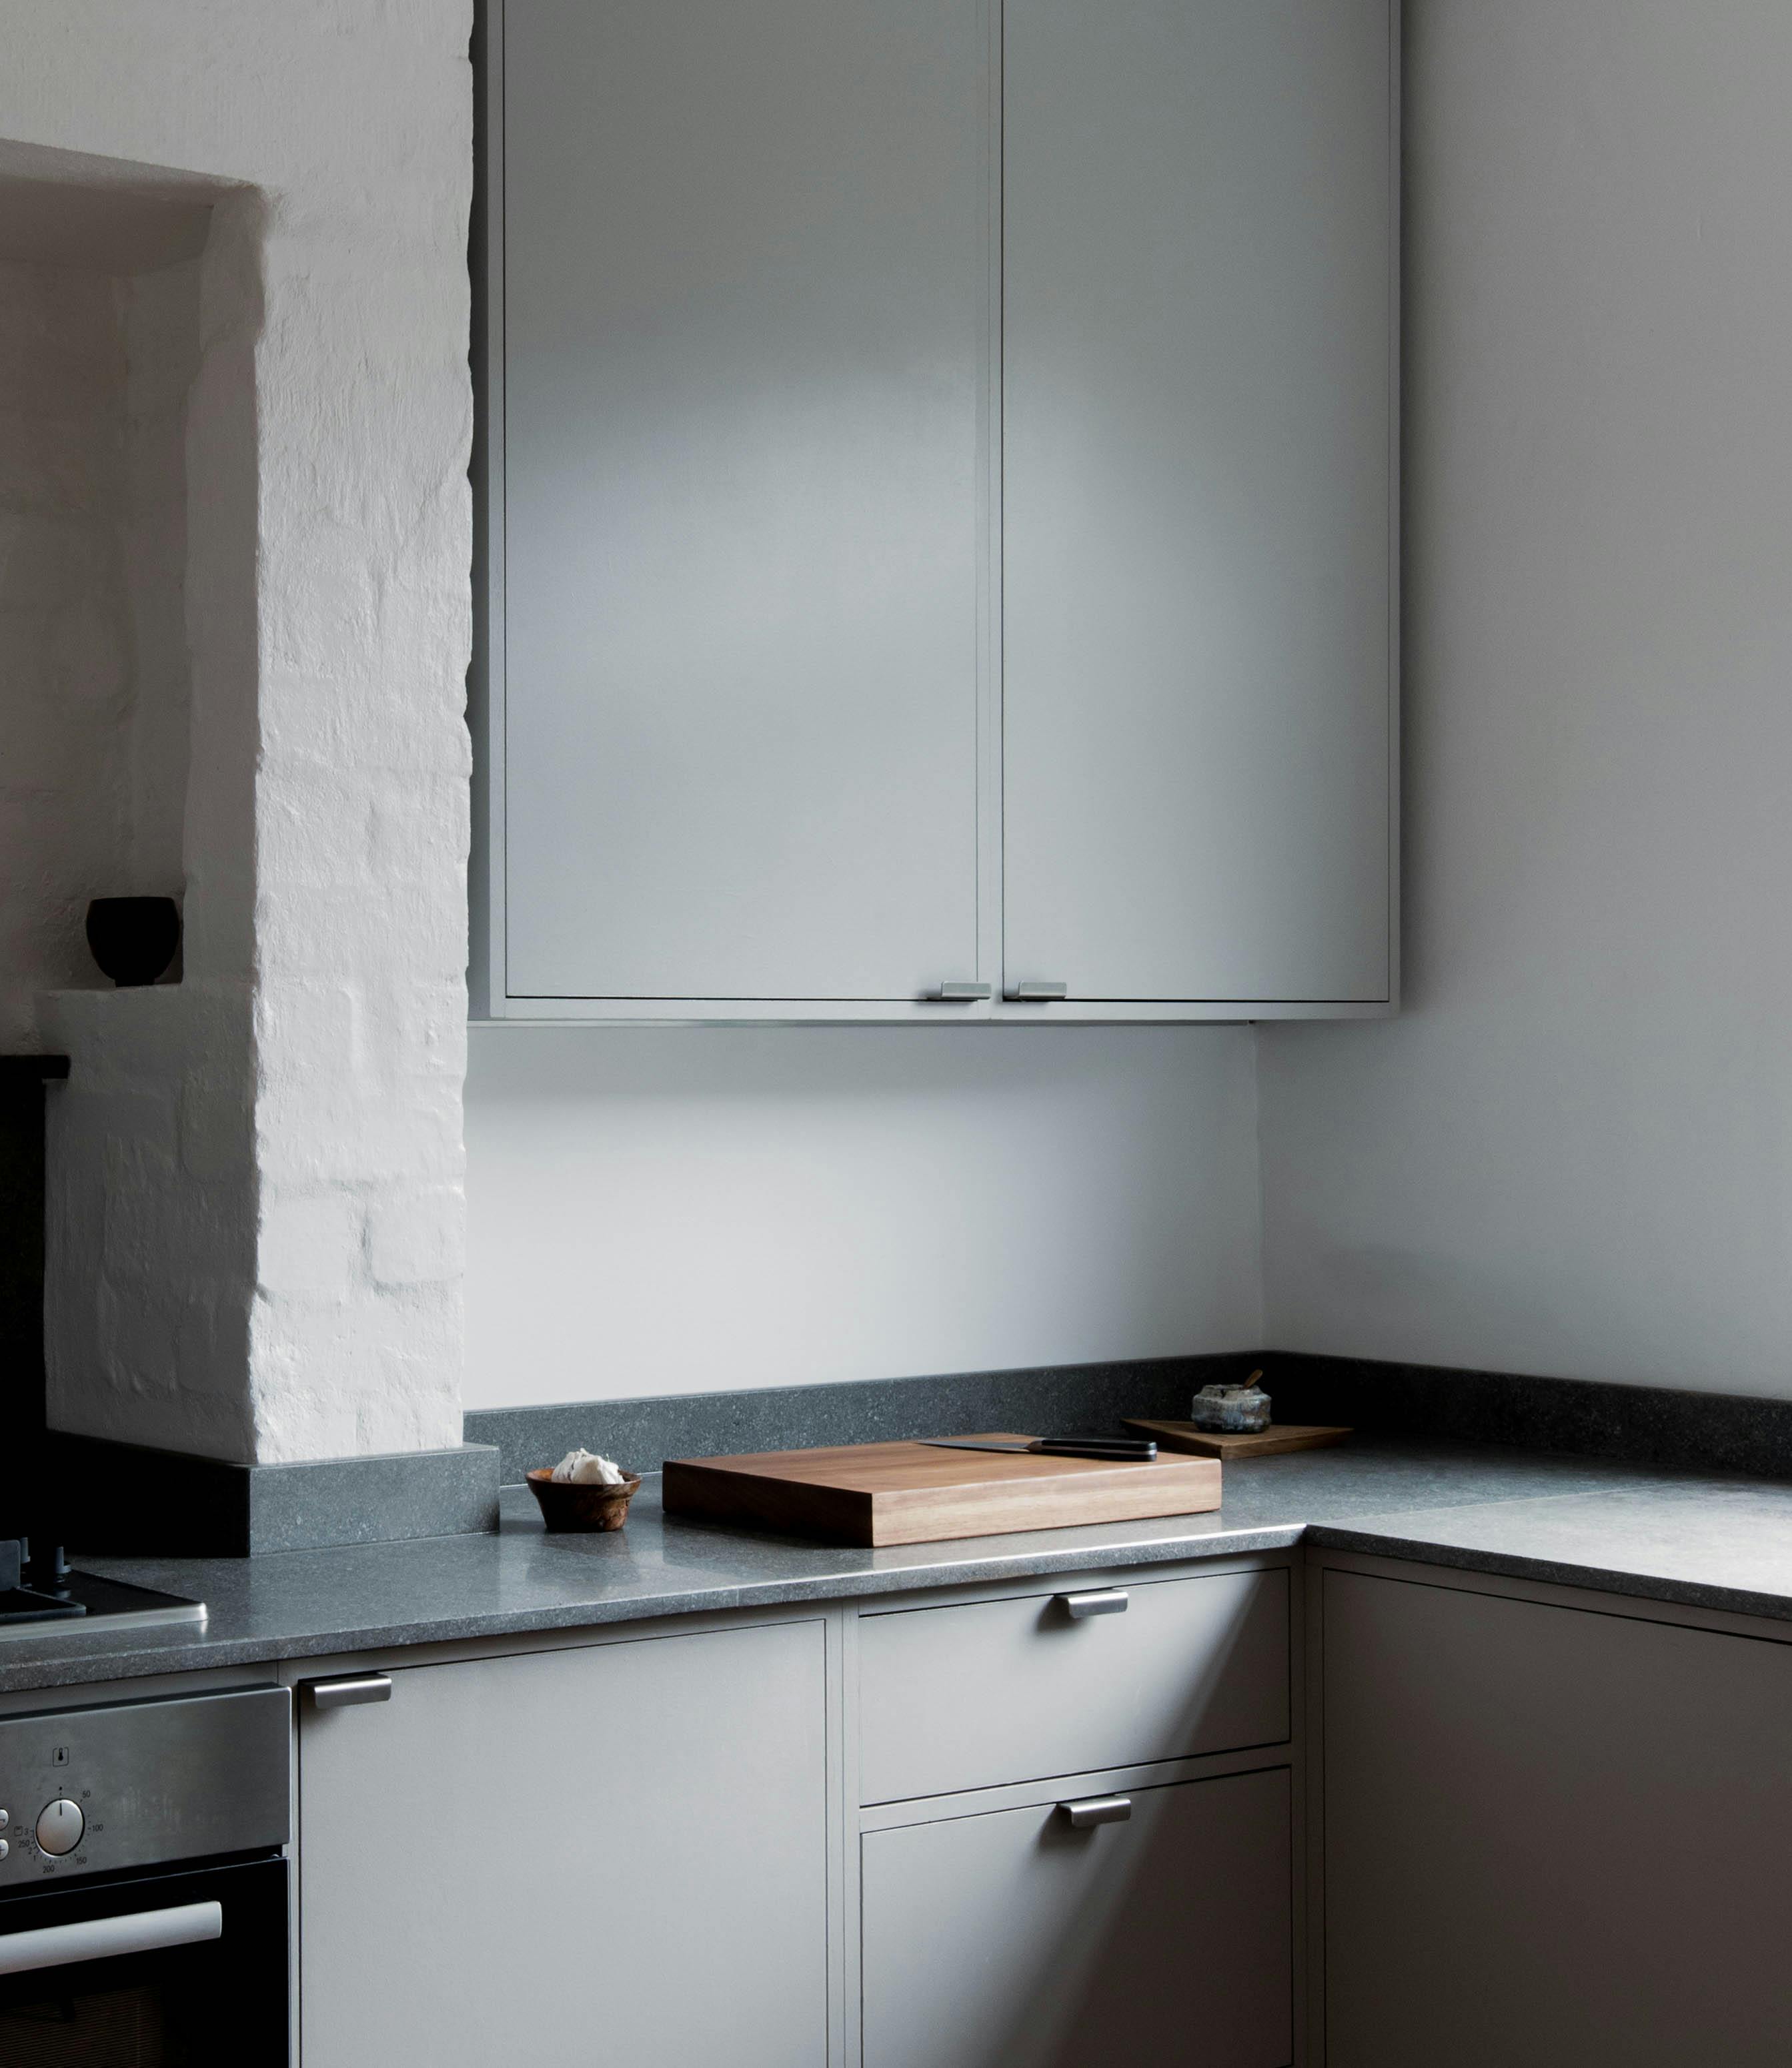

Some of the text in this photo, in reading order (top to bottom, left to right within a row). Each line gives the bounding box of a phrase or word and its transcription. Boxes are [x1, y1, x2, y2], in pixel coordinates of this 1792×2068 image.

[92, 1824, 103, 1832] 100
[18, 1840, 30, 1848] 250
[43, 1865, 55, 1873] 200
